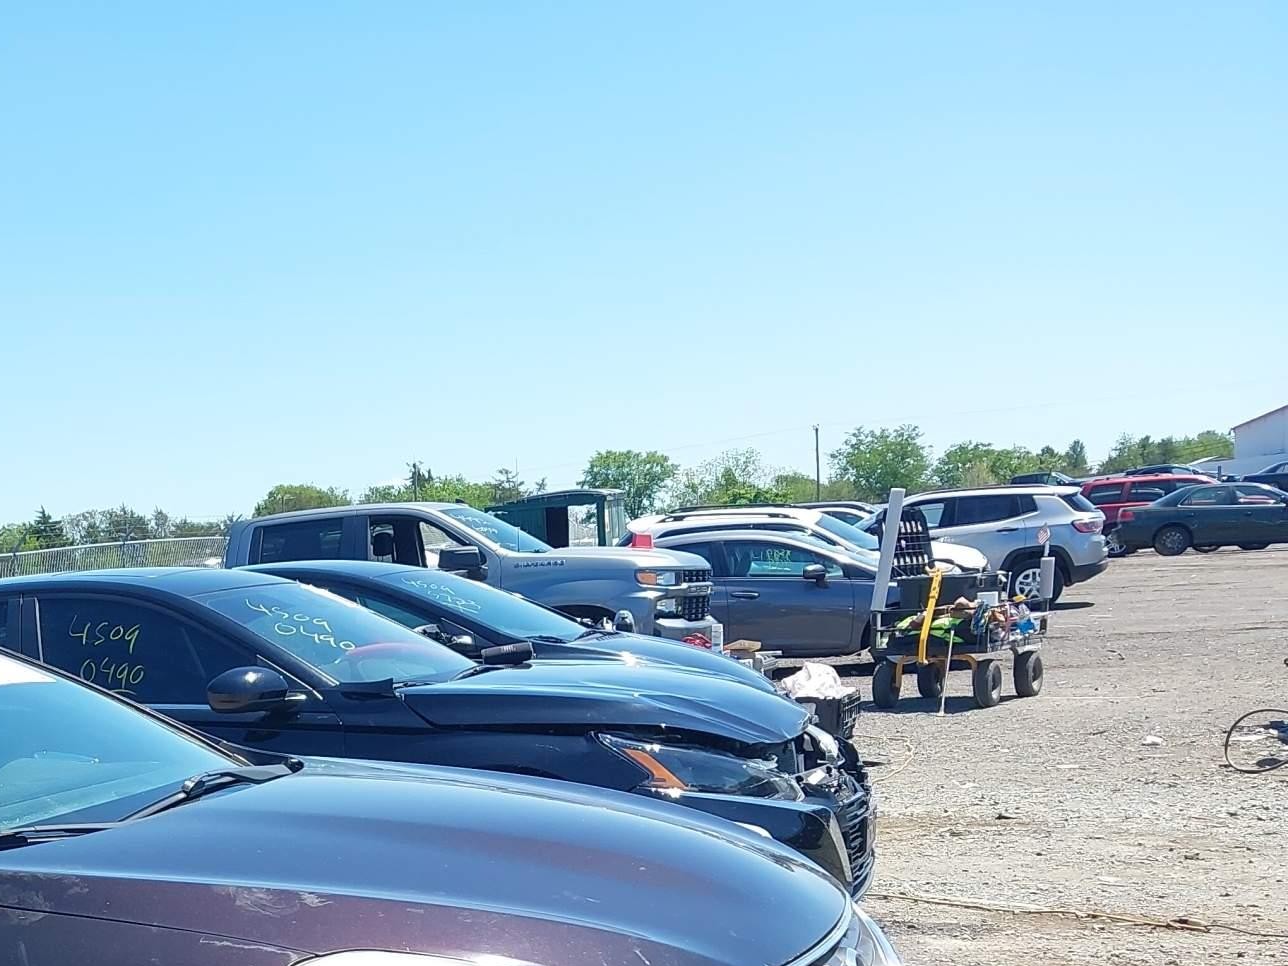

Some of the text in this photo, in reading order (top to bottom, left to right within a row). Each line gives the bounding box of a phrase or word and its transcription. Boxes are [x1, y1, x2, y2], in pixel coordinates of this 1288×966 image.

[246, 599, 334, 633] 4509
[68, 614, 141, 654] 4509
[275, 623, 355, 651] 0490
[80, 657, 145, 690] 0490
